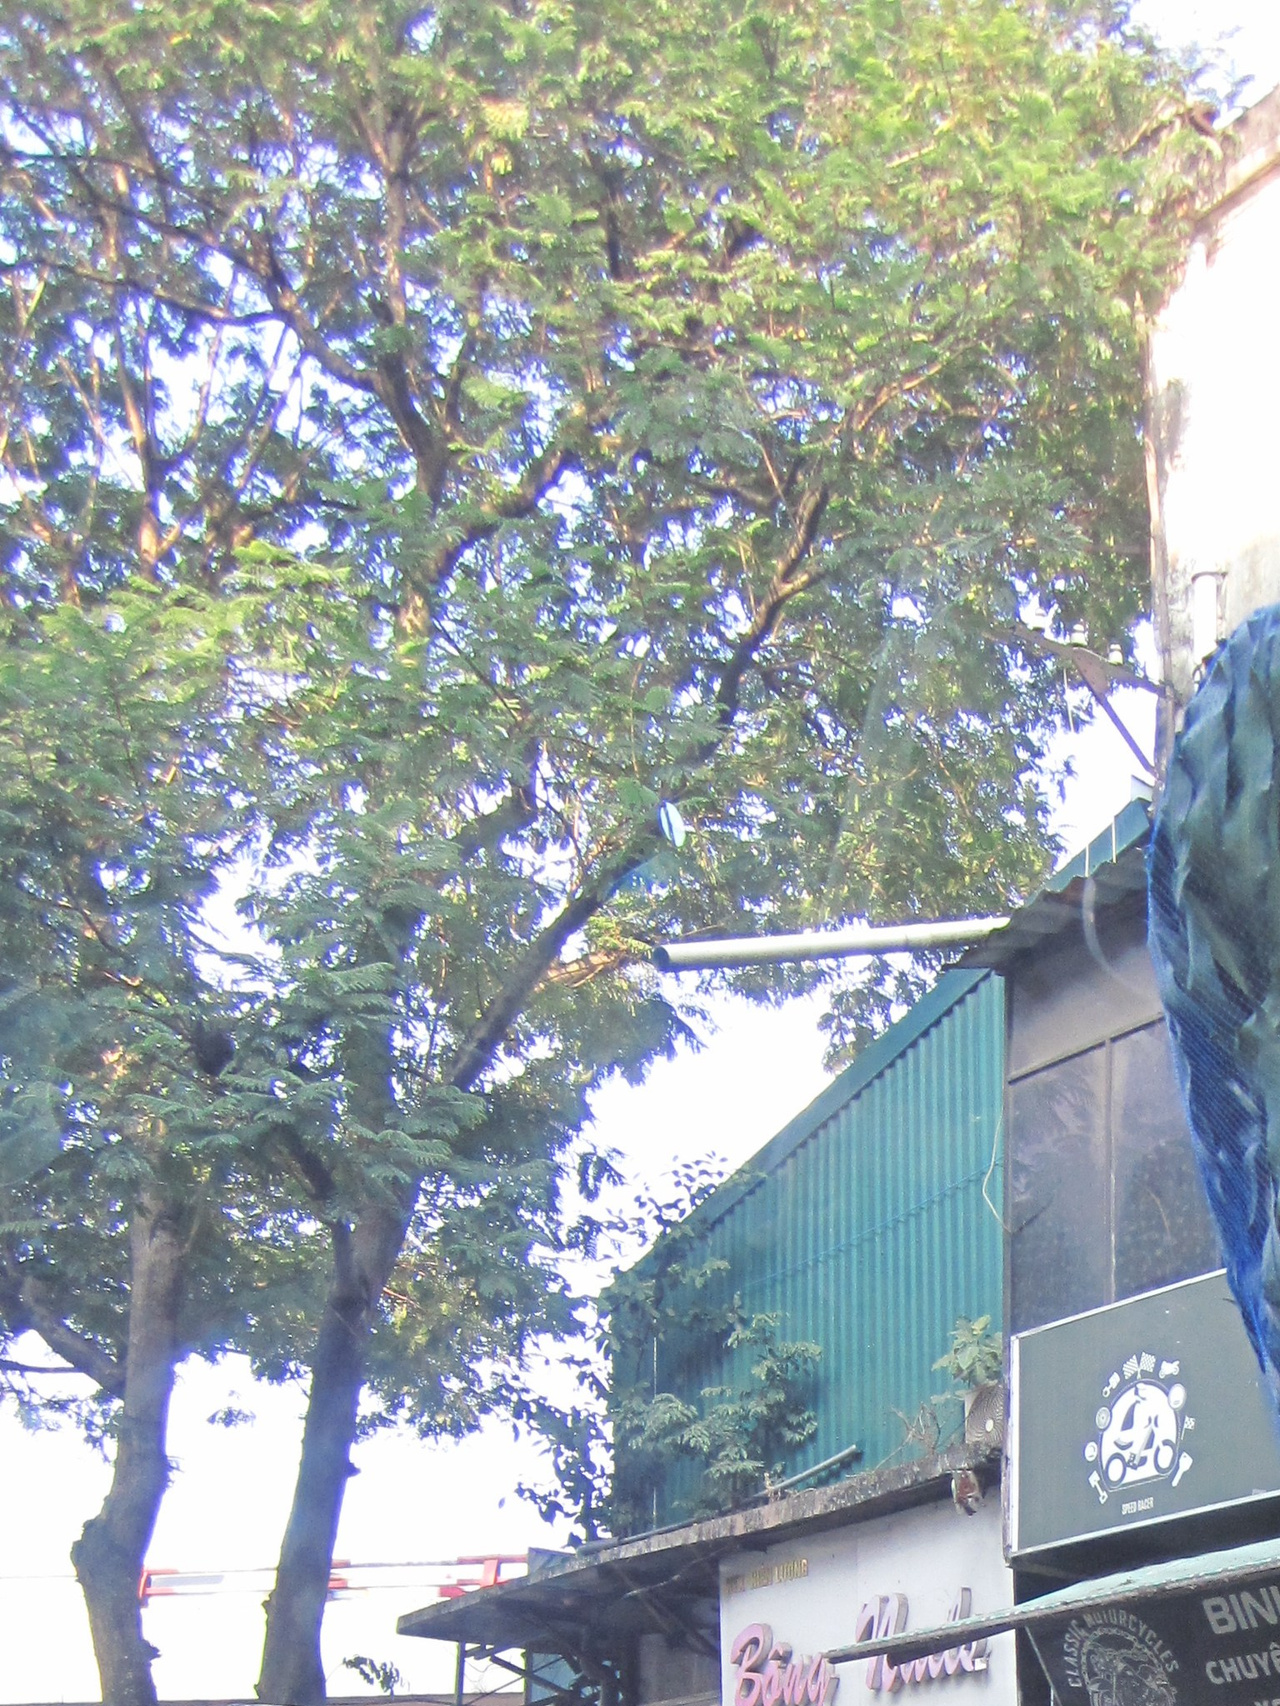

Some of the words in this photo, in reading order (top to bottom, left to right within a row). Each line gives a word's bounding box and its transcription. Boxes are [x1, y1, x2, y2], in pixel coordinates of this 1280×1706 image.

[1121, 1501, 1138, 1515] SPEED
[1137, 1496, 1155, 1512] RACER
[1063, 1619, 1090, 1688] CLASSIC
